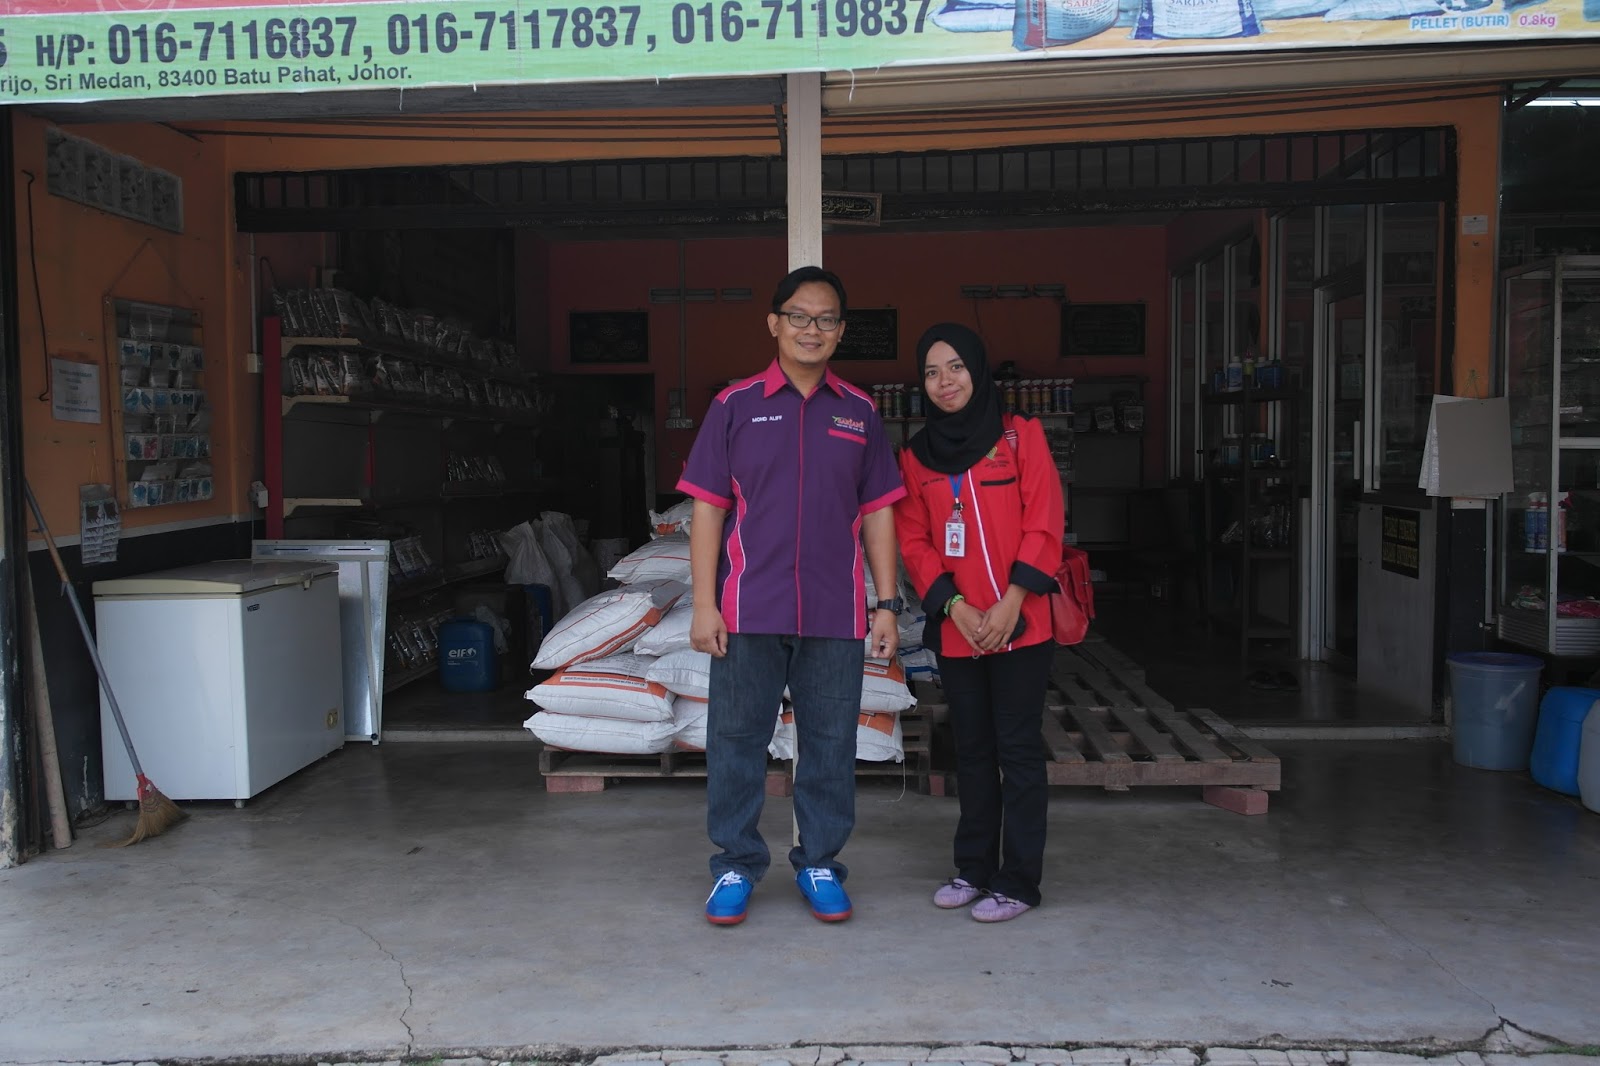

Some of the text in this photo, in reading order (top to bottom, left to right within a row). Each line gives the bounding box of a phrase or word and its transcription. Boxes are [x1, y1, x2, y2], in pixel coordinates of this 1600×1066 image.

[35, 33, 96, 70] H/P:
[108, 16, 373, 65] 016-7116837,
[387, 5, 657, 56] 016-7117837,
[672, 0, 930, 44] 016-7119837
[1411, 13, 1557, 30] PELLET (BUTIR) 0.8kg
[45, 73, 72, 91] Sri
[79, 71, 151, 90] Medan,
[158, 69, 217, 87] 83400
[224, 67, 271, 85] Batu
[278, 65, 341, 84] Pahat,
[347, 63, 412, 82] Johor.
